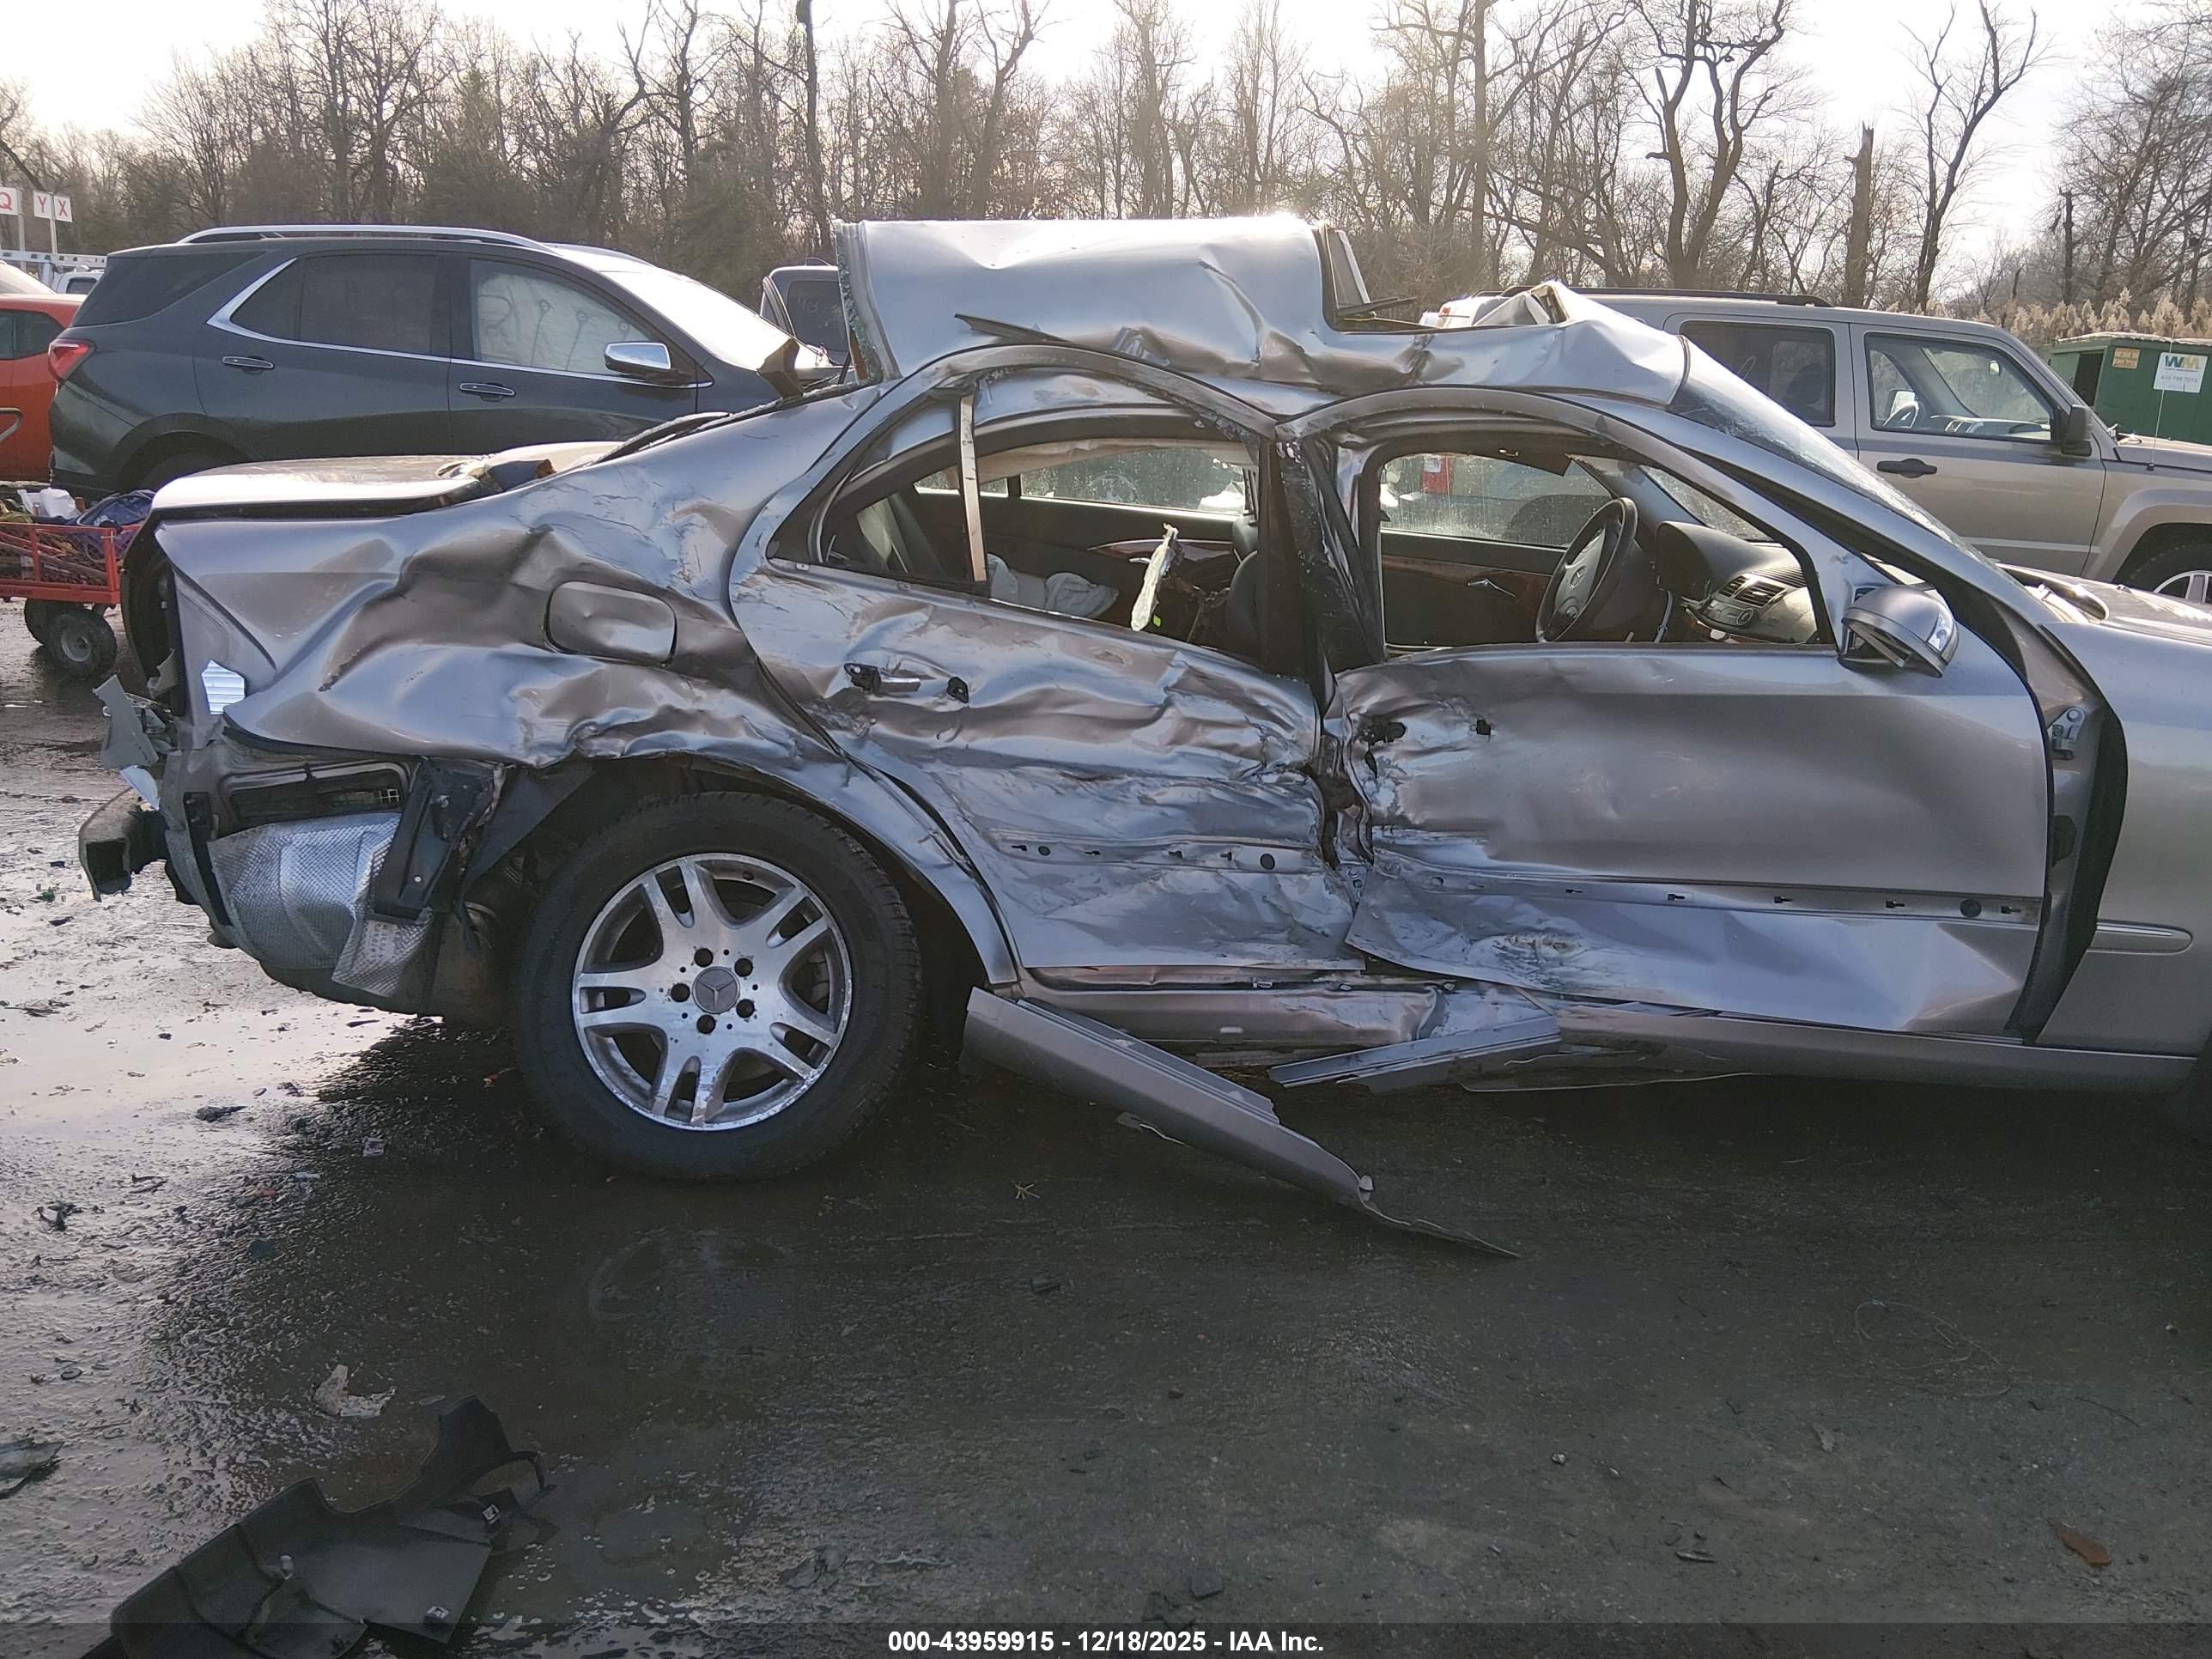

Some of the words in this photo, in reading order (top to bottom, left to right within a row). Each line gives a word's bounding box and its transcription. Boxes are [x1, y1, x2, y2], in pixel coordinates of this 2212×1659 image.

[0, 191, 13, 210] Q
[38, 195, 47, 213] Y
[58, 198, 68, 217] X
[2165, 356, 2199, 369] WM
